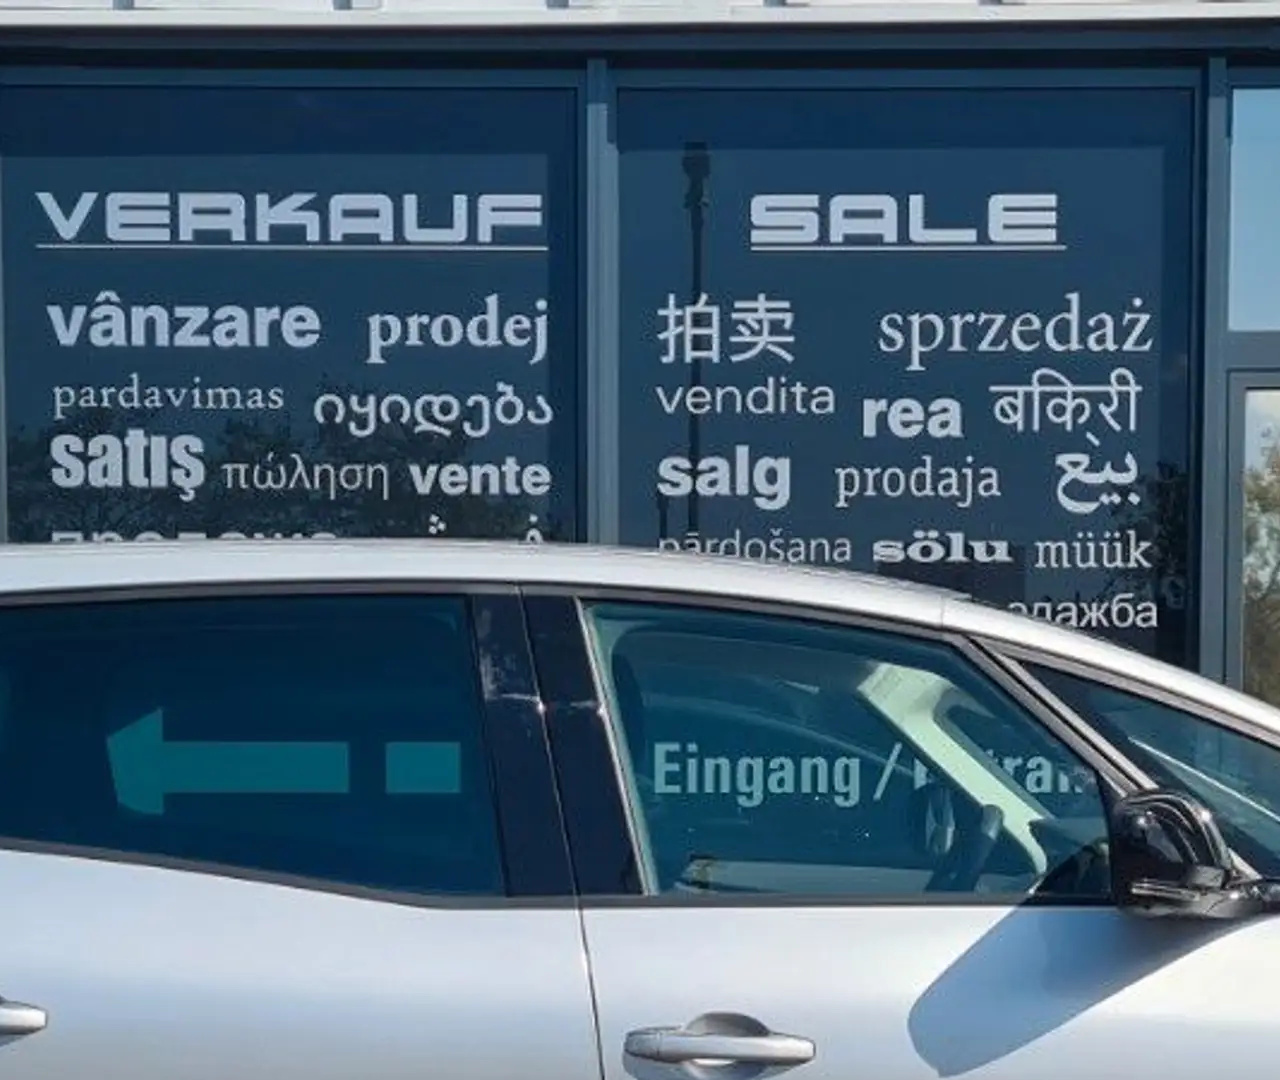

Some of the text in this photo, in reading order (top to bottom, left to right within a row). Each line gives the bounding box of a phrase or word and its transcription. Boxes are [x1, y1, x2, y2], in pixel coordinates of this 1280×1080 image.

[35, 192, 542, 243] VERKAUF
[750, 193, 1058, 244] SALE
[46, 290, 548, 365] vânzare prodej
[657, 293, 795, 364] 拍卖
[879, 292, 1153, 371] sprzedaż
[53, 372, 284, 420] pardavimas
[313, 381, 553, 438] იყიდება
[656, 376, 964, 439] vendita rea
[50, 428, 205, 502] satış
[221, 451, 389, 501] πώληση
[409, 456, 551, 496] vente
[657, 444, 1002, 511] salg prodaja
[872, 529, 1012, 563] sölu
[1034, 529, 1152, 568] müük
[654, 742, 860, 808] Eingang
